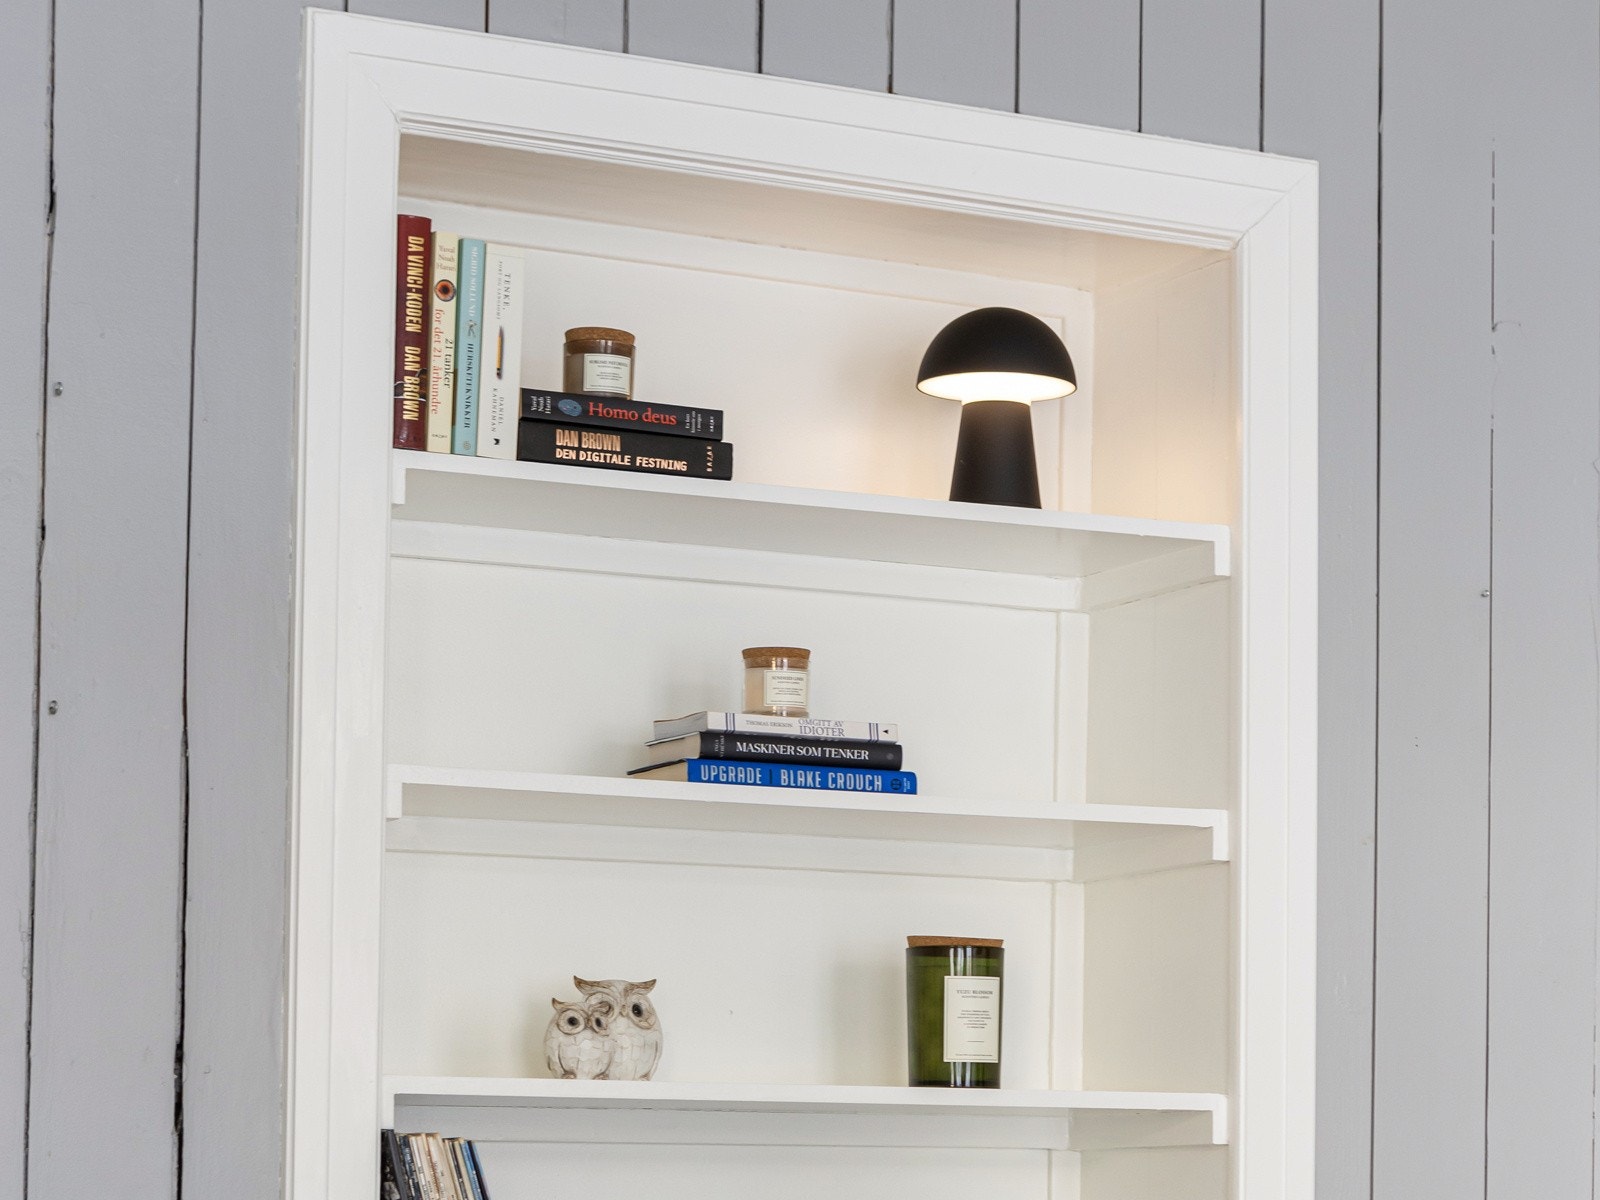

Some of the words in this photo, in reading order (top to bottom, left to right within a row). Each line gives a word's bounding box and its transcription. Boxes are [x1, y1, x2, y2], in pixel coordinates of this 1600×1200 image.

[407, 235, 425, 252] DA
[405, 255, 424, 333] VINCI-KODEN
[434, 308, 445, 325] for
[433, 326, 444, 342] det
[444, 338, 453, 350] 21
[404, 346, 421, 371] DAN
[443, 354, 454, 389] tanker
[403, 375, 420, 421] BROWN
[431, 365, 442, 415] århundre
[490, 387, 498, 433] KAHNEMAN
[497, 396, 505, 425] DANIEL
[530, 396, 538, 412] Yuval
[537, 396, 545, 413] Noah
[544, 396, 552, 414] Harari
[588, 402, 639, 421] Homo
[642, 407, 678, 426] deus
[556, 428, 578, 448] DAN
[581, 431, 621, 451] BROWN
[556, 449, 579, 461] DEN
[579, 451, 631, 466] DIGITALE
[636, 456, 688, 471] FESTNING
[745, 719, 769, 728] THOMAS
[798, 718, 832, 727] OMGITT
[833, 720, 844, 728] AV
[800, 725, 845, 737] IDIOTER
[736, 741, 796, 756] MASKINER
[797, 746, 820, 756] SOM
[820, 747, 869, 761] TENKER
[701, 764, 762, 784] UPGRADE
[780, 766, 822, 787] BLAKE
[828, 772, 882, 792] CROUCH
